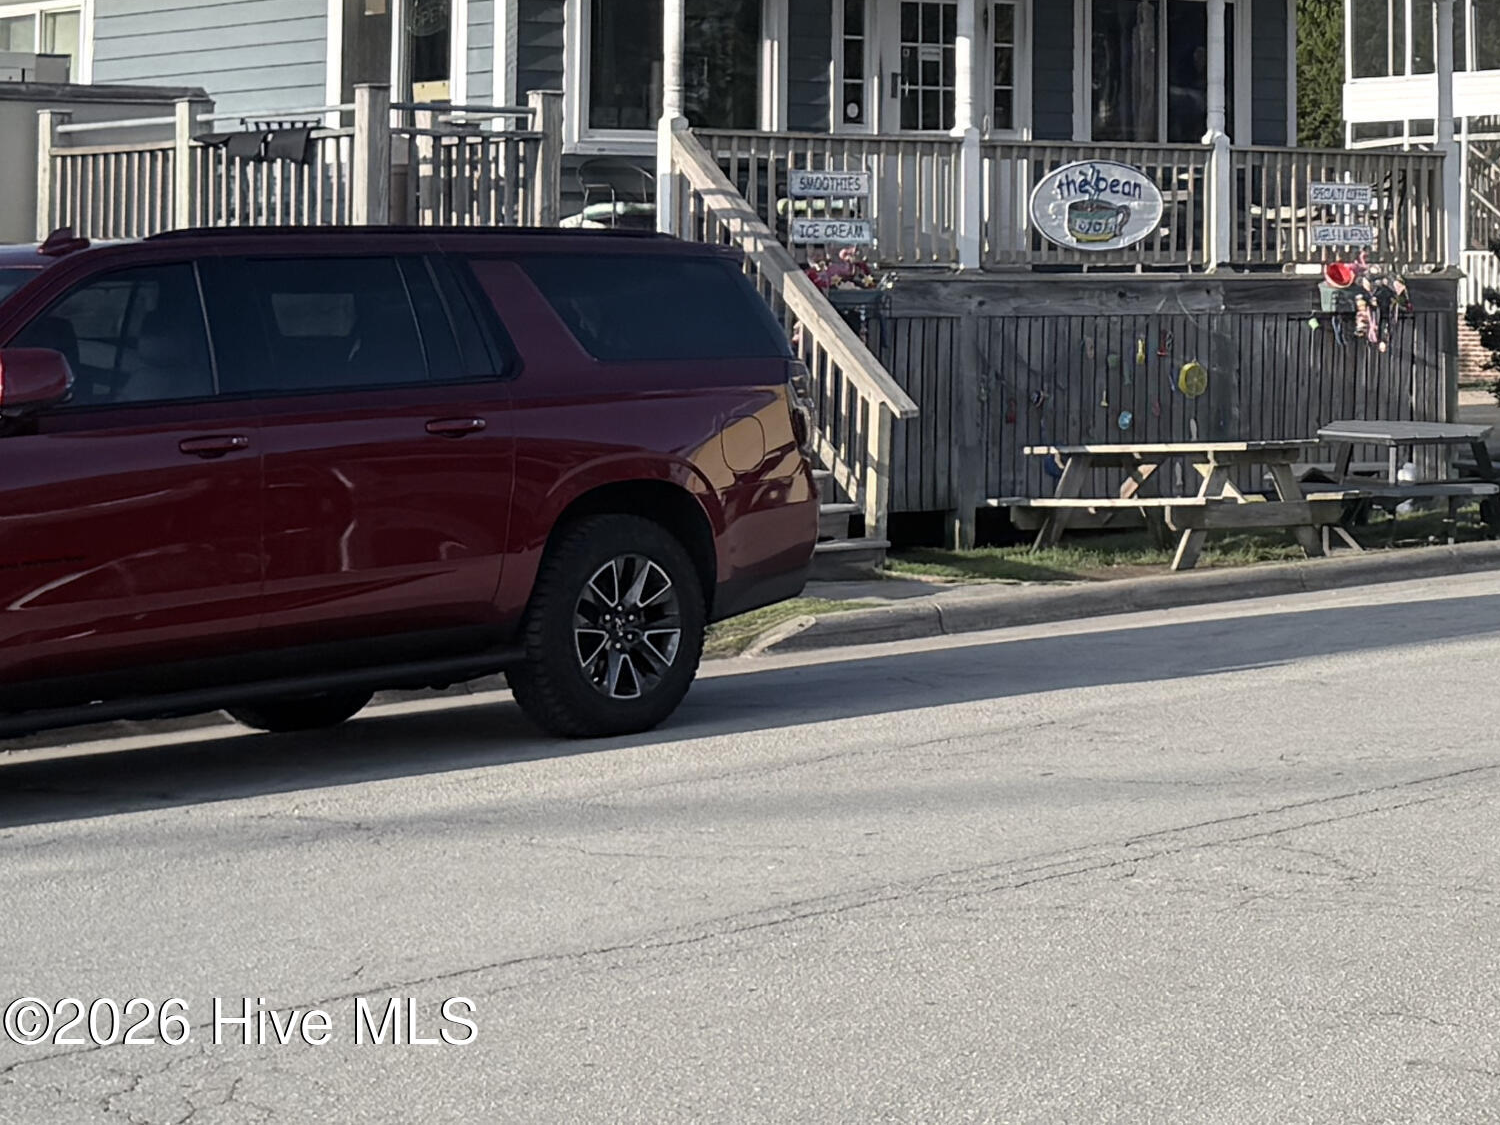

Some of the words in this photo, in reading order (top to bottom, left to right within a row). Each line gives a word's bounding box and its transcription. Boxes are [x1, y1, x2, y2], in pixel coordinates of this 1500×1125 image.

[799, 176, 861, 191] SMOOTHIES
[1057, 173, 1090, 199] the
[1095, 169, 1142, 199] bean
[799, 224, 820, 239] ICE
[824, 224, 865, 239] CREAM
